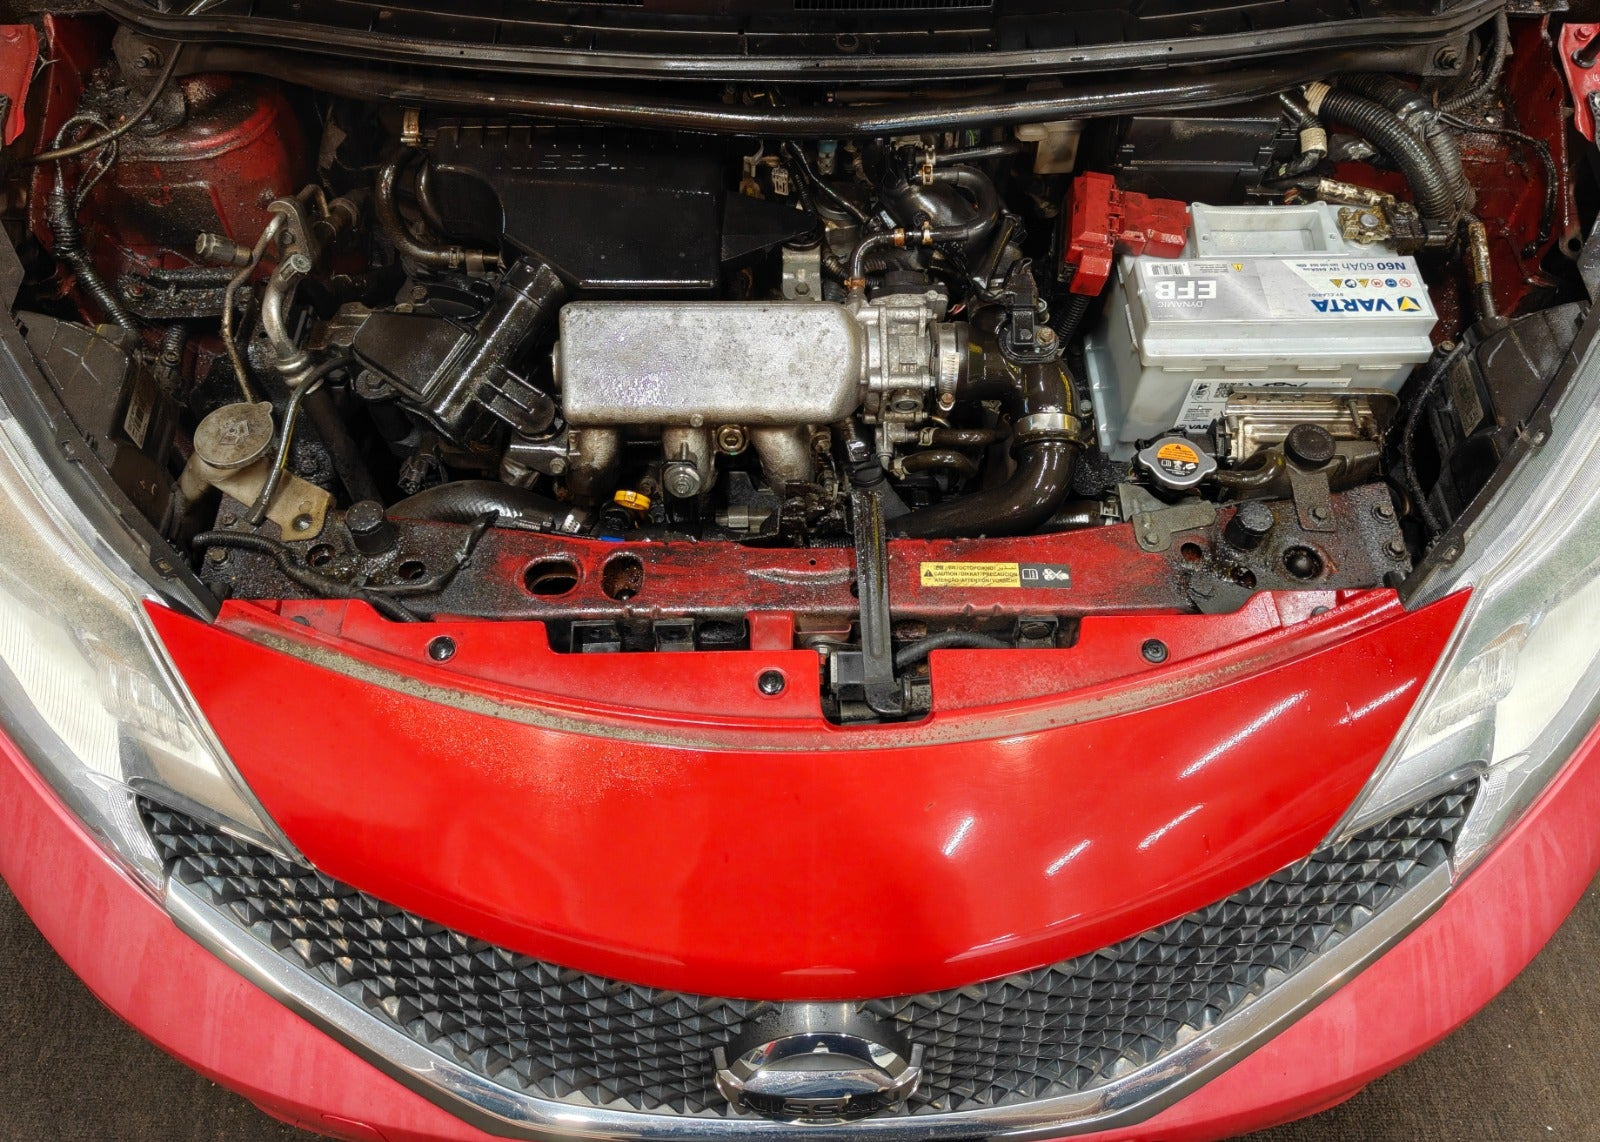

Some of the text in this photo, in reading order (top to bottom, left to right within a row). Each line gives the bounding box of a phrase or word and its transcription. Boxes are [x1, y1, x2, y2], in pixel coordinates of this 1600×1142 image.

[1341, 262, 1374, 271] 60Ah
[1377, 262, 1406, 271] N60
[1154, 280, 1217, 299] EFB
[1310, 298, 1394, 312] VARTA
